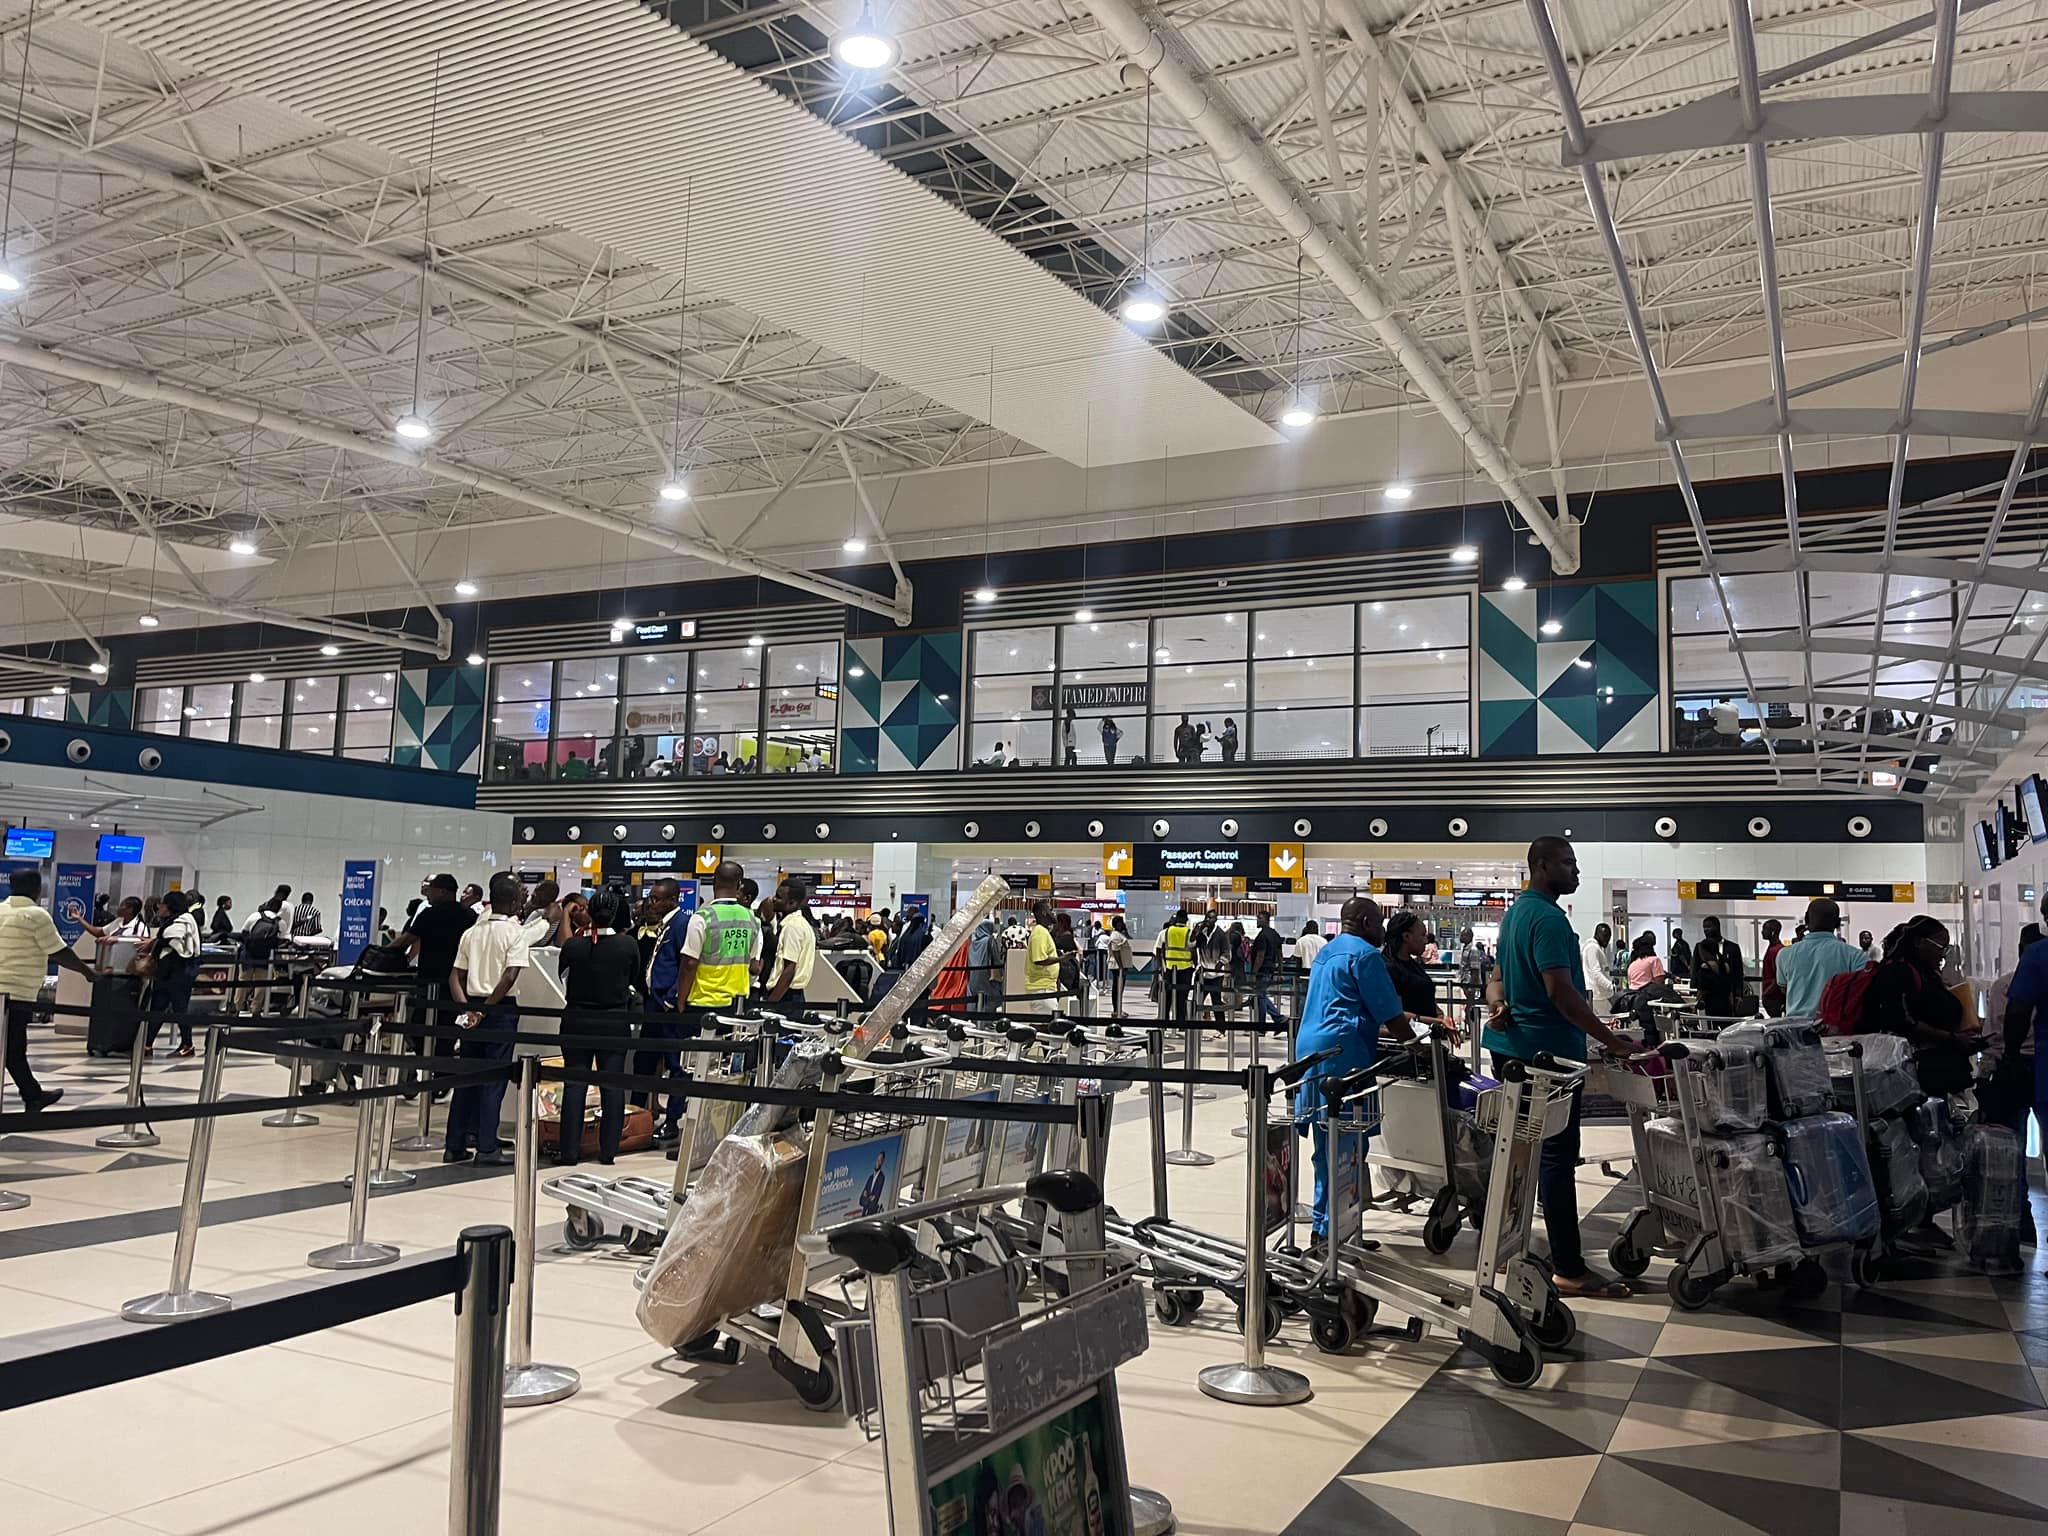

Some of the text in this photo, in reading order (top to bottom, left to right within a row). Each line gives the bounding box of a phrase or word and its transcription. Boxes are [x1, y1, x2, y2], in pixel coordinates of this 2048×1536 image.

[1048, 687, 1103, 704] UTAMED
[620, 849, 677, 860] Passport Control
[1160, 849, 1239, 861] Passport Control
[1162, 880, 1171, 888] 20
[1294, 881, 1304, 890] 22
[1439, 883, 1449, 892] 24
[1680, 887, 1696, 896] E-1
[1894, 888, 1913, 898] E-4
[343, 898, 372, 907] CHECK-IN
[348, 924, 365, 932] WORLD
[724, 929, 749, 939] APSS
[727, 940, 746, 950] 721
[821, 1178, 854, 1195] onfidence.
